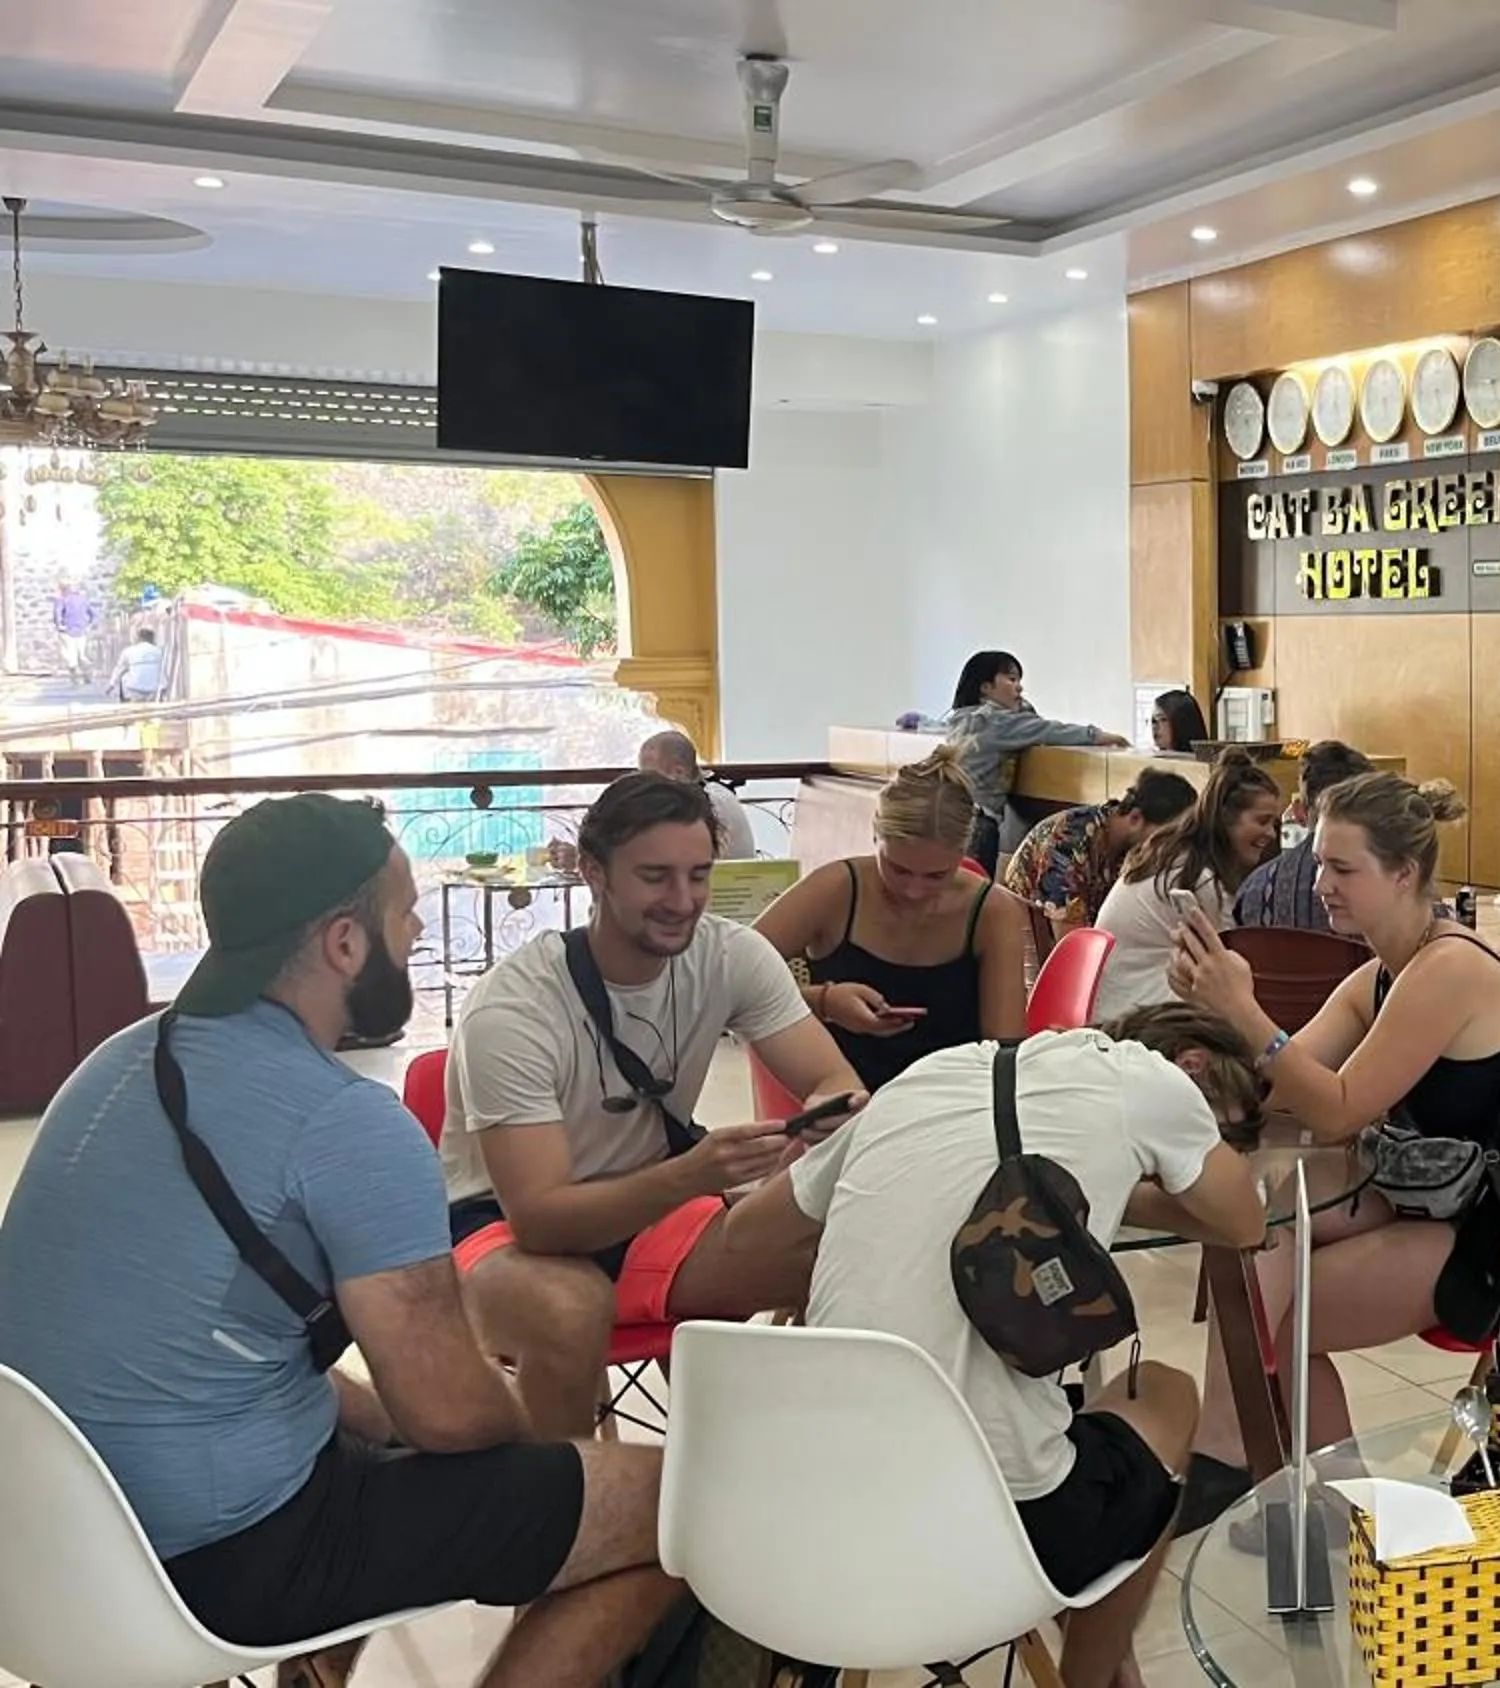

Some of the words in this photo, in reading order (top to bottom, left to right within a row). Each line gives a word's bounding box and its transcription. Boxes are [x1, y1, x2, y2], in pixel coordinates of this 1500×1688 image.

[1247, 487, 1313, 540] CAT
[1321, 483, 1372, 535] BA
[1296, 547, 1430, 600] HOTEL
